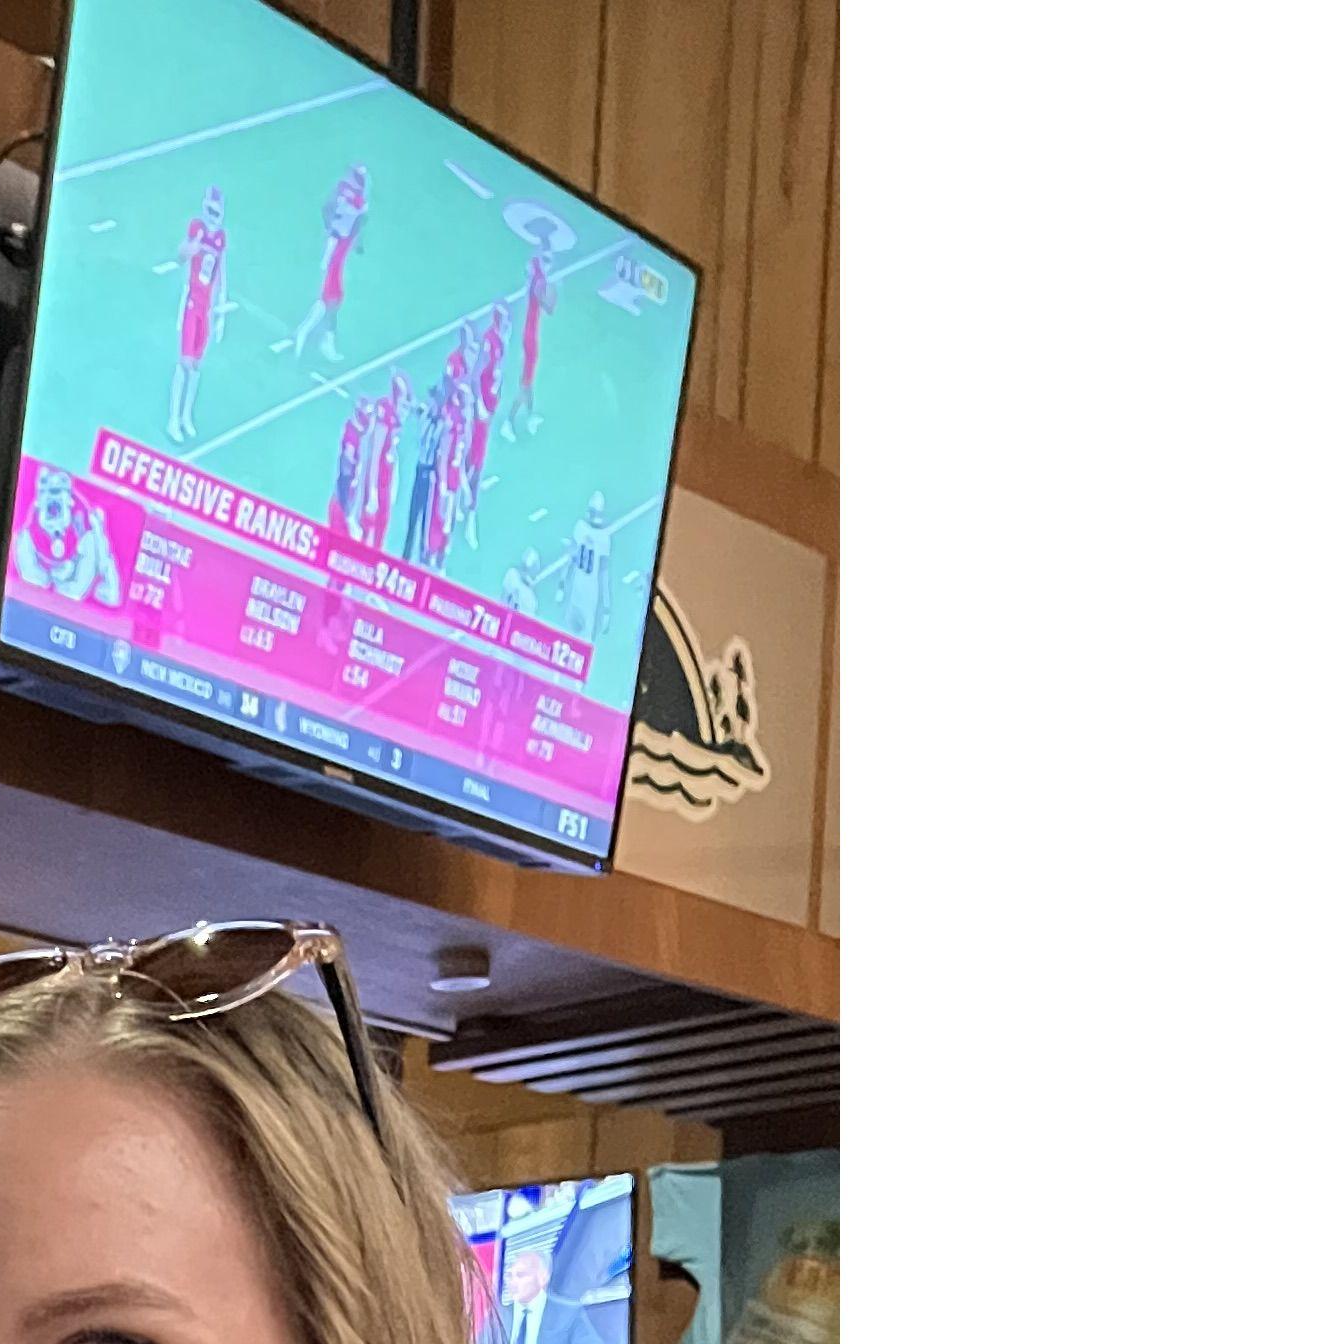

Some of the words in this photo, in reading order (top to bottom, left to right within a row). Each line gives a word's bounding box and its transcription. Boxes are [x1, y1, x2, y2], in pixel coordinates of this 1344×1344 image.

[100, 437, 235, 524] OFFENSIVE
[234, 496, 320, 562] RANKS:
[557, 807, 589, 841] FS1
